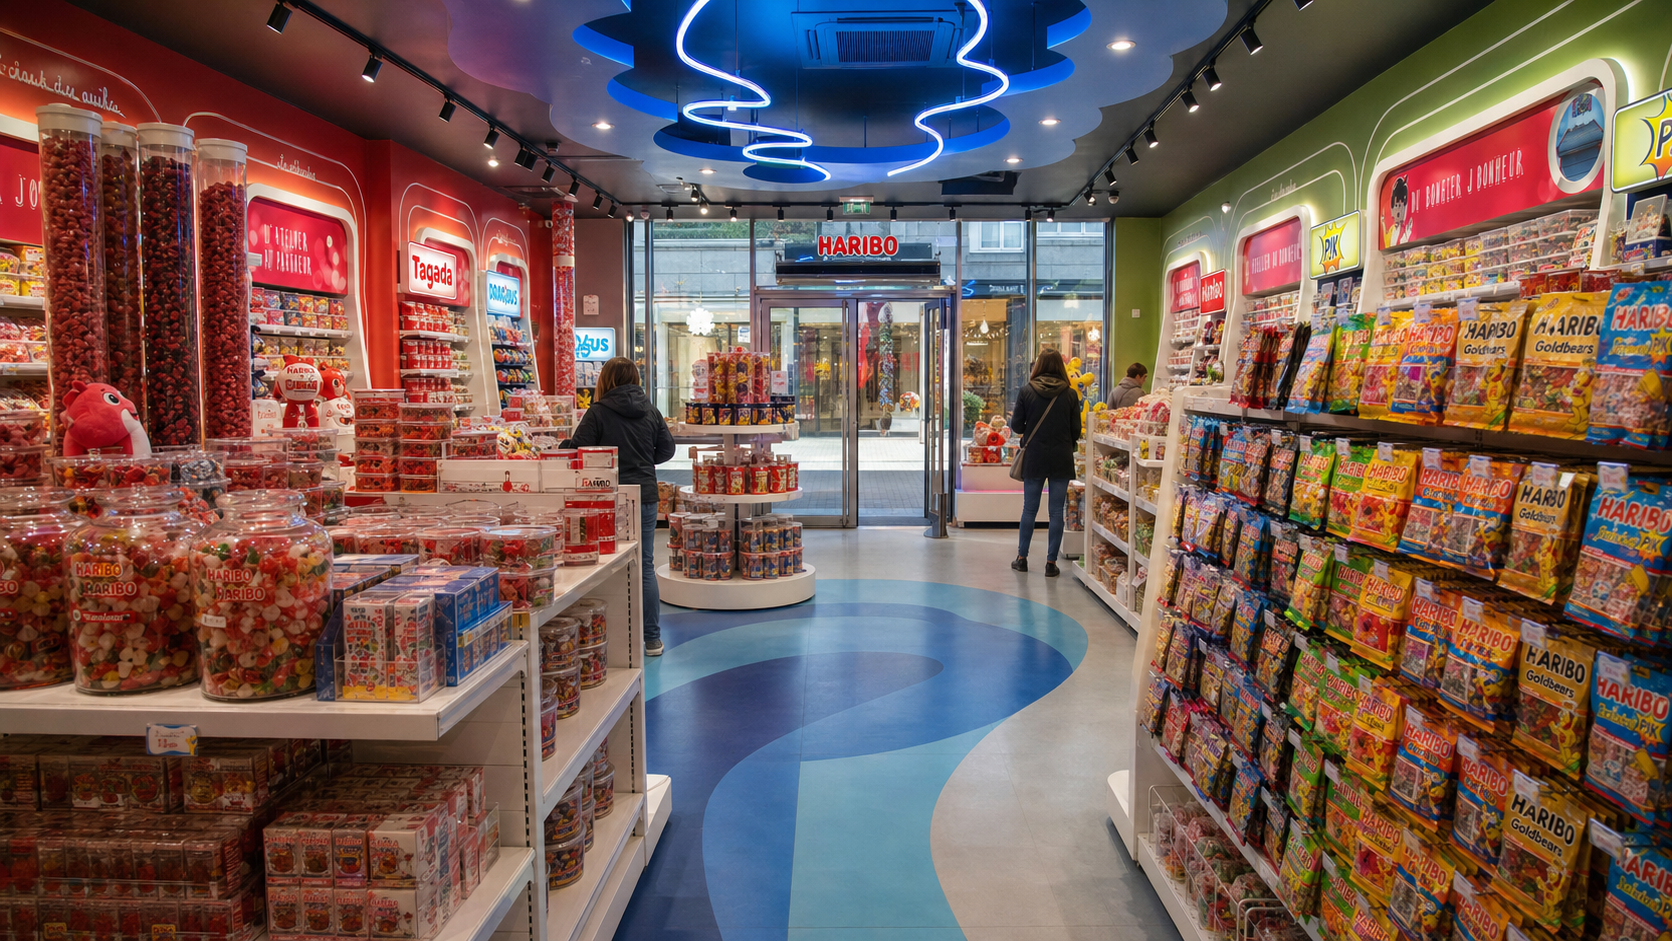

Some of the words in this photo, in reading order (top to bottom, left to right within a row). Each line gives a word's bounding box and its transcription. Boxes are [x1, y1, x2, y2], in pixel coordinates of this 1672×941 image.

[1477, 147, 1524, 191] BONHEUR
[817, 235, 899, 257] HARIBO
[412, 255, 453, 289] Tagada
[1535, 340, 1594, 355] Goldbears
[1420, 468, 1460, 491] HARIB
[1597, 496, 1672, 534] HARIBO
[74, 562, 123, 578] HARIBO
[207, 568, 253, 582] HARIBO
[1458, 617, 1513, 653] HARIBO
[1525, 644, 1587, 684] HARIBO
[1525, 668, 1575, 699] Goldbears
[1597, 674, 1669, 720] HARIBO
[1404, 721, 1452, 759] HARIBO
[1461, 755, 1508, 797] HARIBO
[1360, 803, 1402, 845] HARIBO
[1509, 792, 1577, 847] HARIBO
